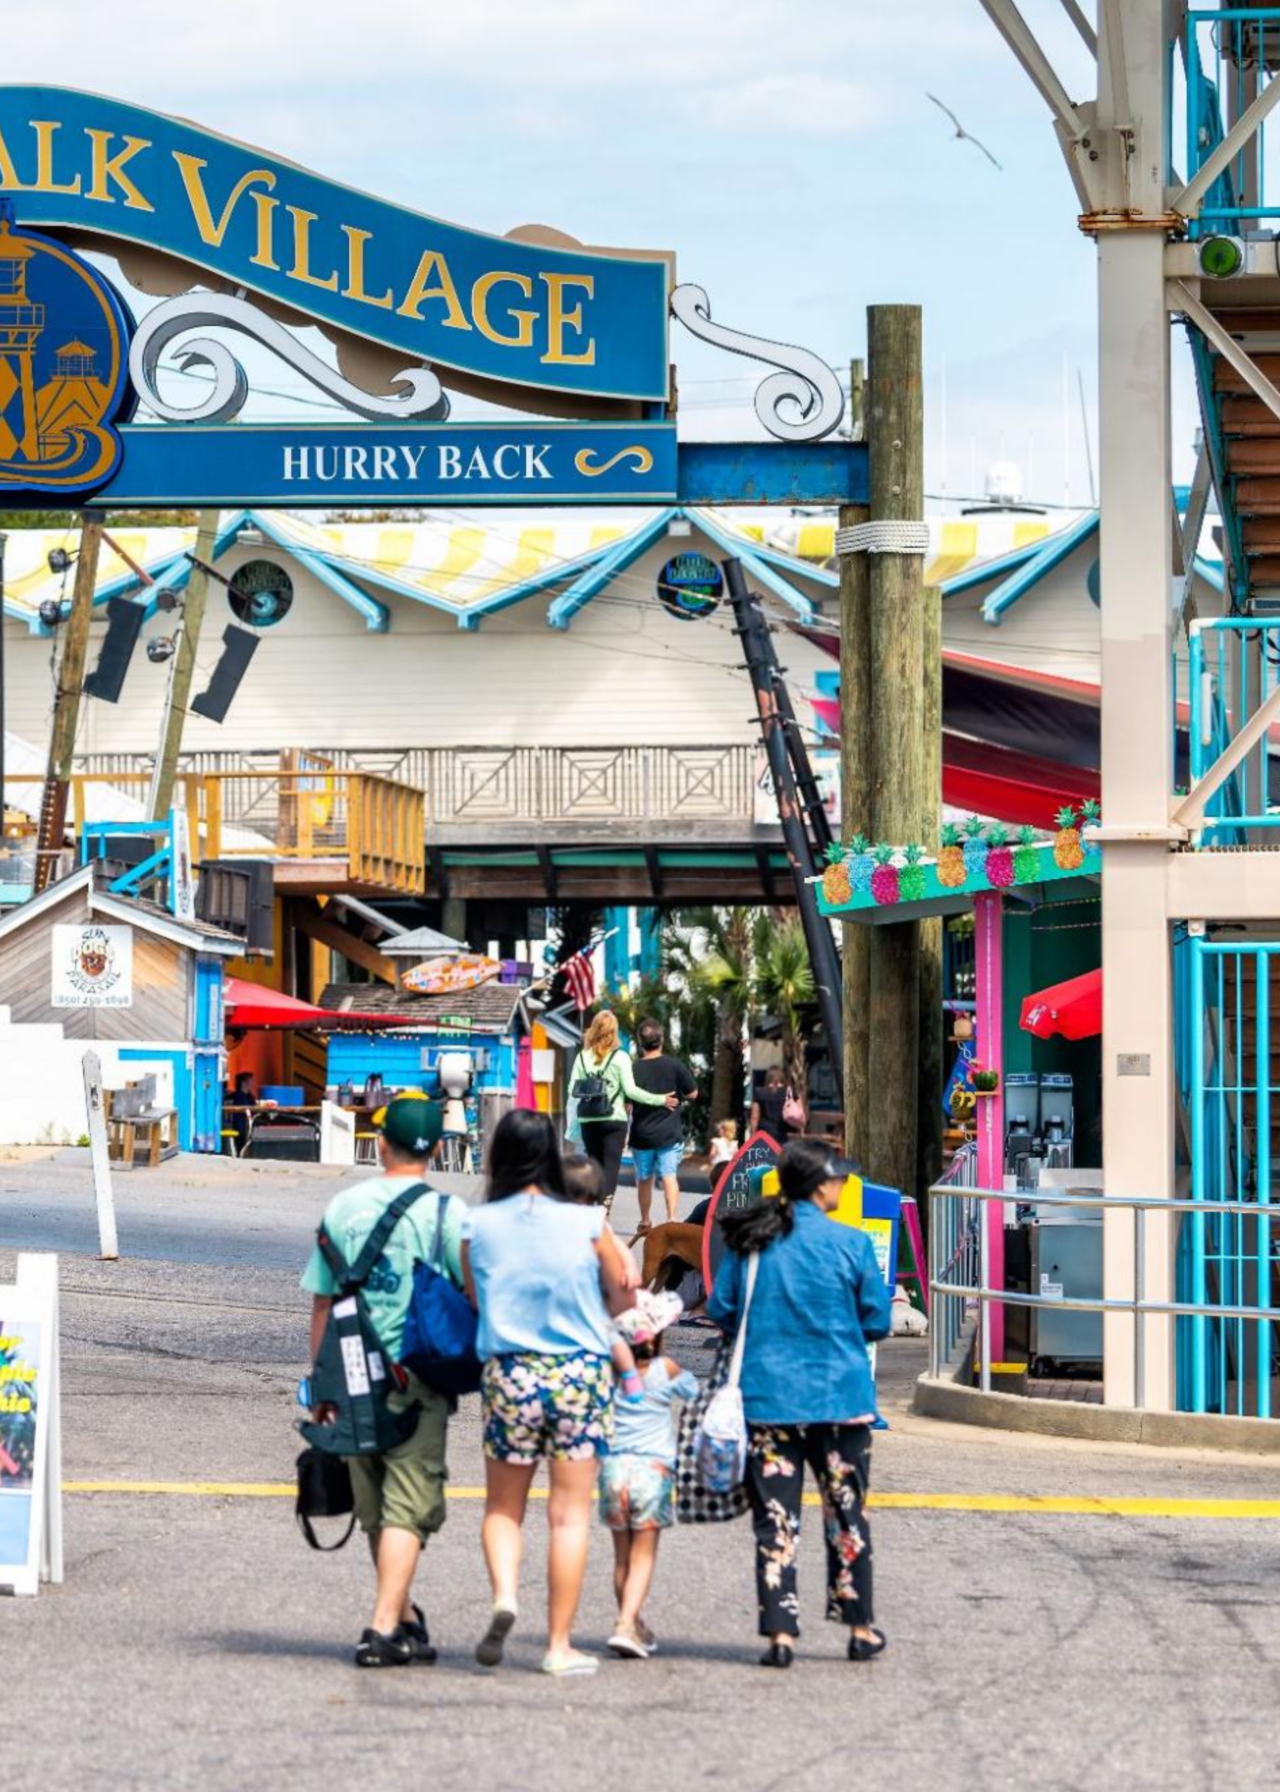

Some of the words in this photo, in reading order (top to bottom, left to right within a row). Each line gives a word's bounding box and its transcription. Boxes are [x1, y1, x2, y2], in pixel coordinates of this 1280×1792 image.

[171, 150, 596, 366] VILLAGE
[282, 445, 428, 481] HURRY
[436, 443, 554, 480] BACK
[66, 972, 121, 993] PARASAIL
[748, 1148, 770, 1160] TRY
